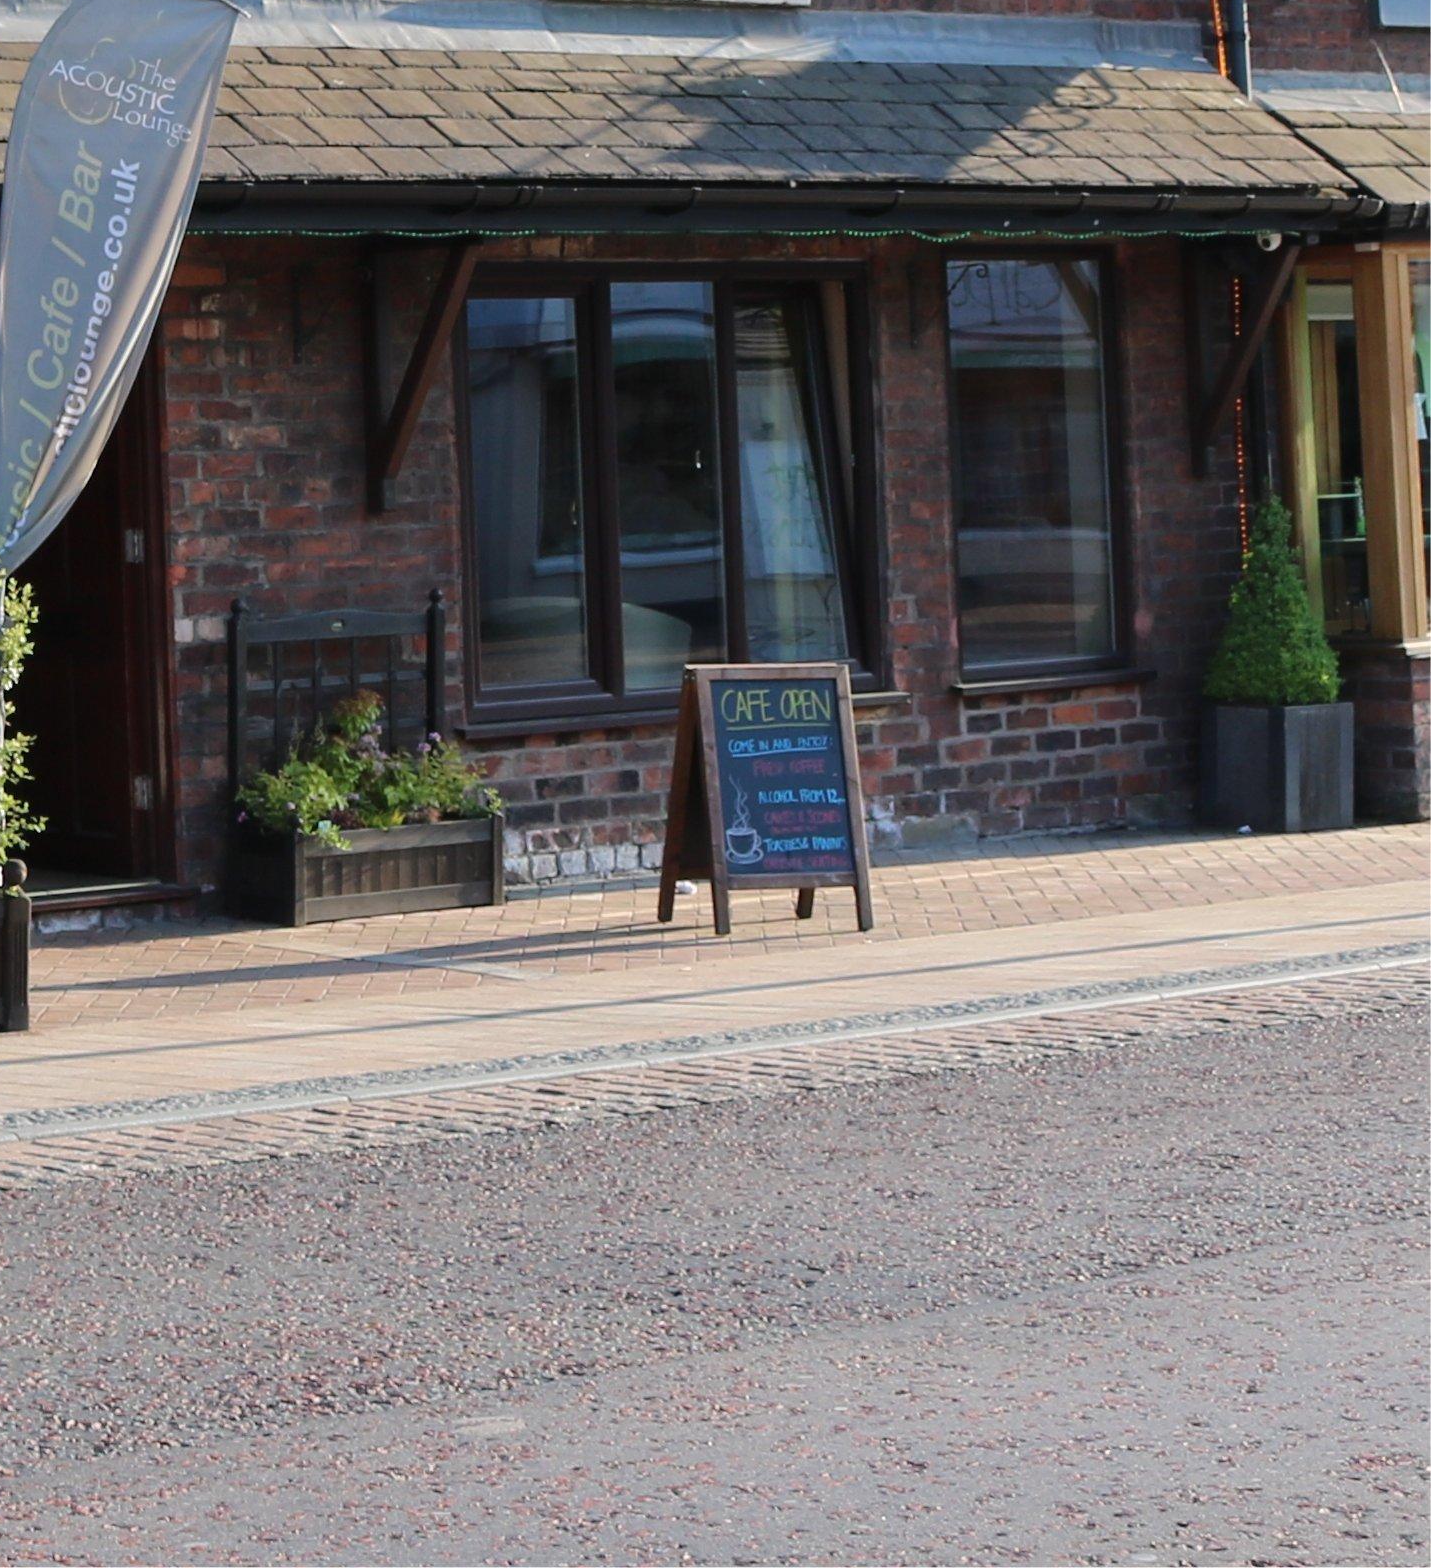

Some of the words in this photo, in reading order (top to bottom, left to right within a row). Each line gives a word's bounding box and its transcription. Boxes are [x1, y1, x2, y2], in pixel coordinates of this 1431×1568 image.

[48, 59, 176, 115] ACOUSTIC
[139, 58, 176, 92] The
[112, 100, 192, 148] Lounge
[27, 277, 79, 390] Cafe
[58, 139, 103, 232] Bar
[721, 689, 775, 723] CAFE
[780, 688, 831, 721] OPEN
[728, 738, 756, 753] COME
[759, 739, 770, 751] IN
[758, 789, 799, 804] ALCOHOL
[799, 788, 826, 803] FROM
